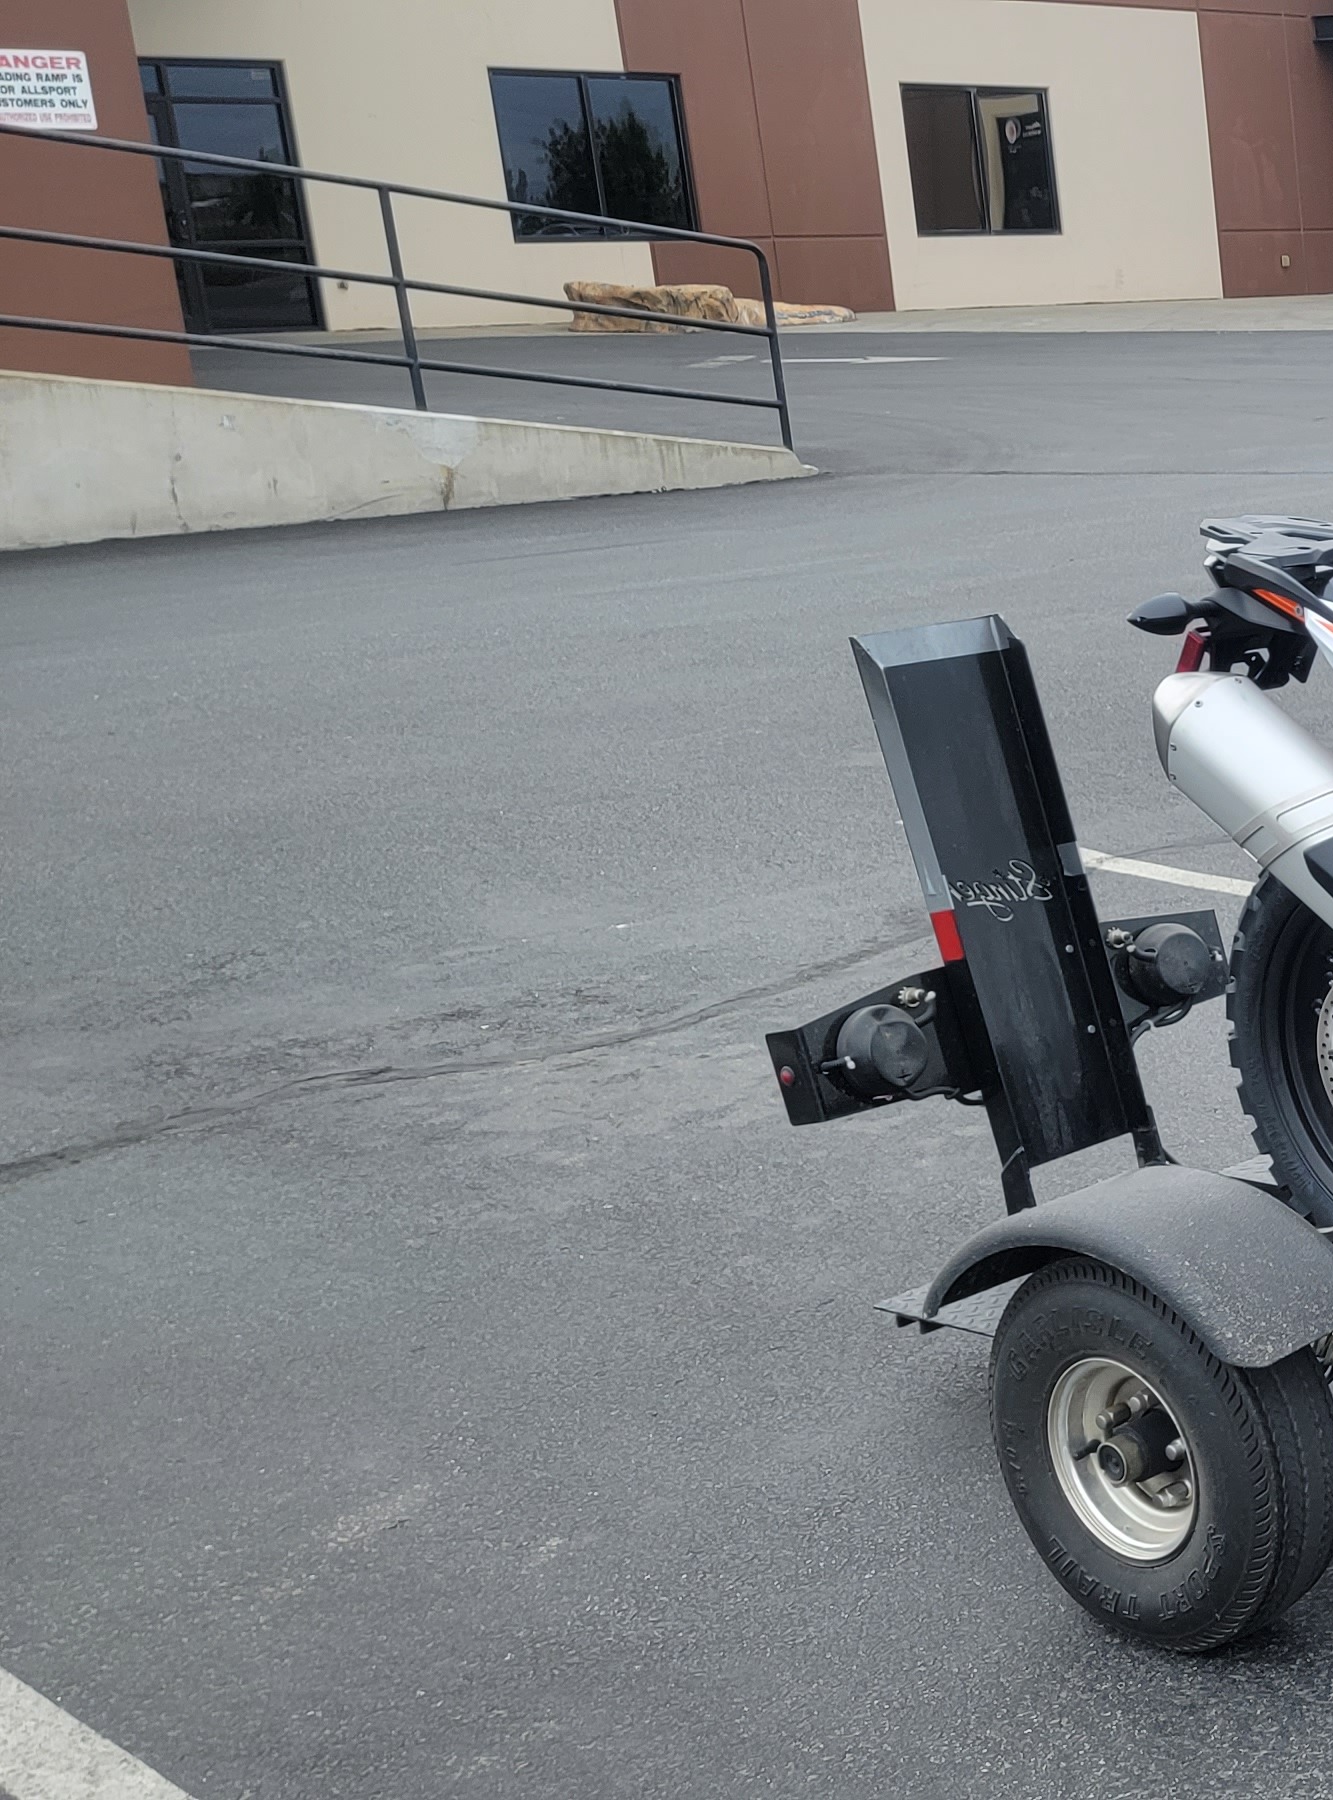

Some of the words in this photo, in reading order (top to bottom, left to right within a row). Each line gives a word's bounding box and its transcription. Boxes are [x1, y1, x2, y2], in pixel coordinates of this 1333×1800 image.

[35, 73, 67, 82] RAMP
[72, 74, 83, 83] IS
[21, 86, 77, 95] ALLSPORT
[0, 98, 55, 107] STOMERS
[60, 99, 88, 108] ONLY
[1048, 1534, 1142, 1622] TRAIL
